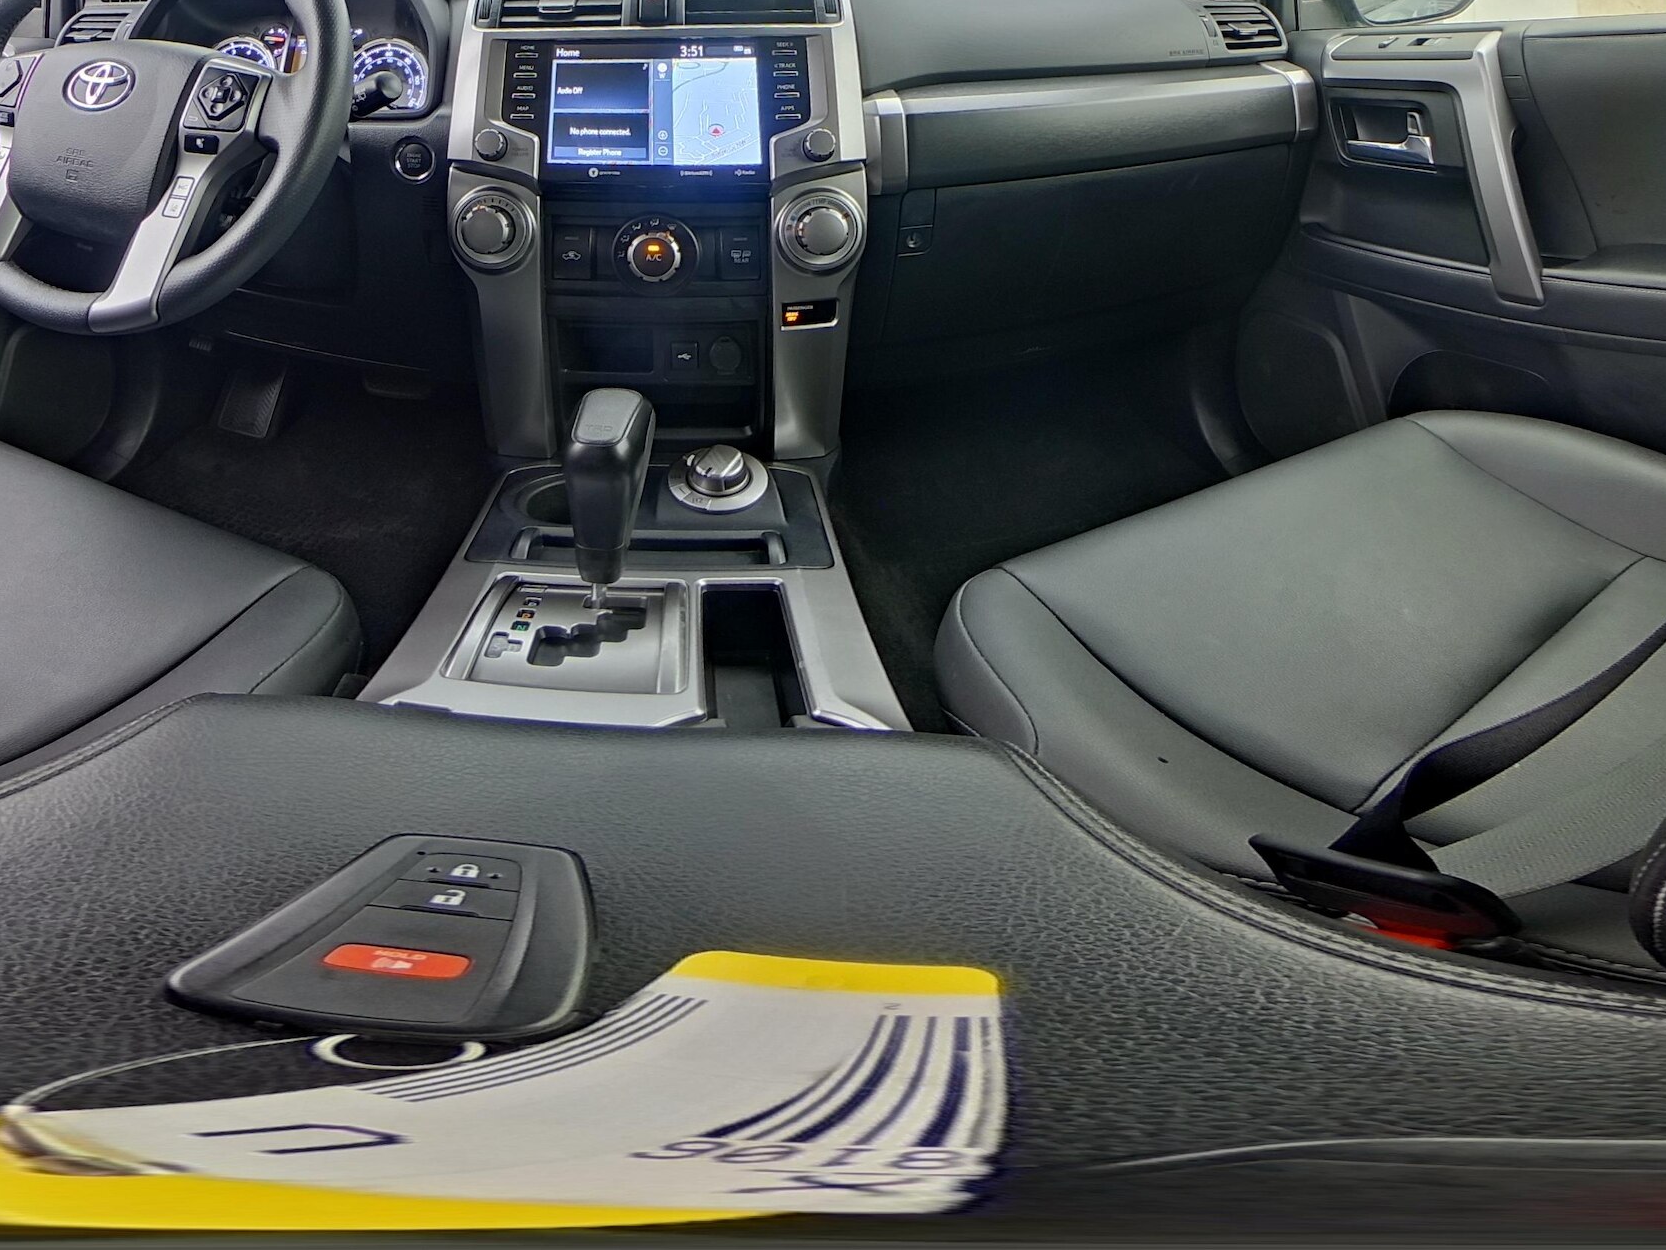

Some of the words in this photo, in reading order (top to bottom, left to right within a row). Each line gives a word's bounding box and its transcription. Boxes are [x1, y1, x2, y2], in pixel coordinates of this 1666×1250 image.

[556, 48, 581, 57] Home
[679, 45, 704, 58] 3:51
[573, 86, 584, 95] Off
[569, 126, 579, 136] No
[580, 127, 598, 137] phone
[599, 127, 631, 137] connected.
[577, 148, 602, 157] Register
[602, 148, 622, 157] Phone
[645, 253, 662, 262] A/C
[515, 623, 527, 631] N
[373, 950, 428, 961] HOLD
